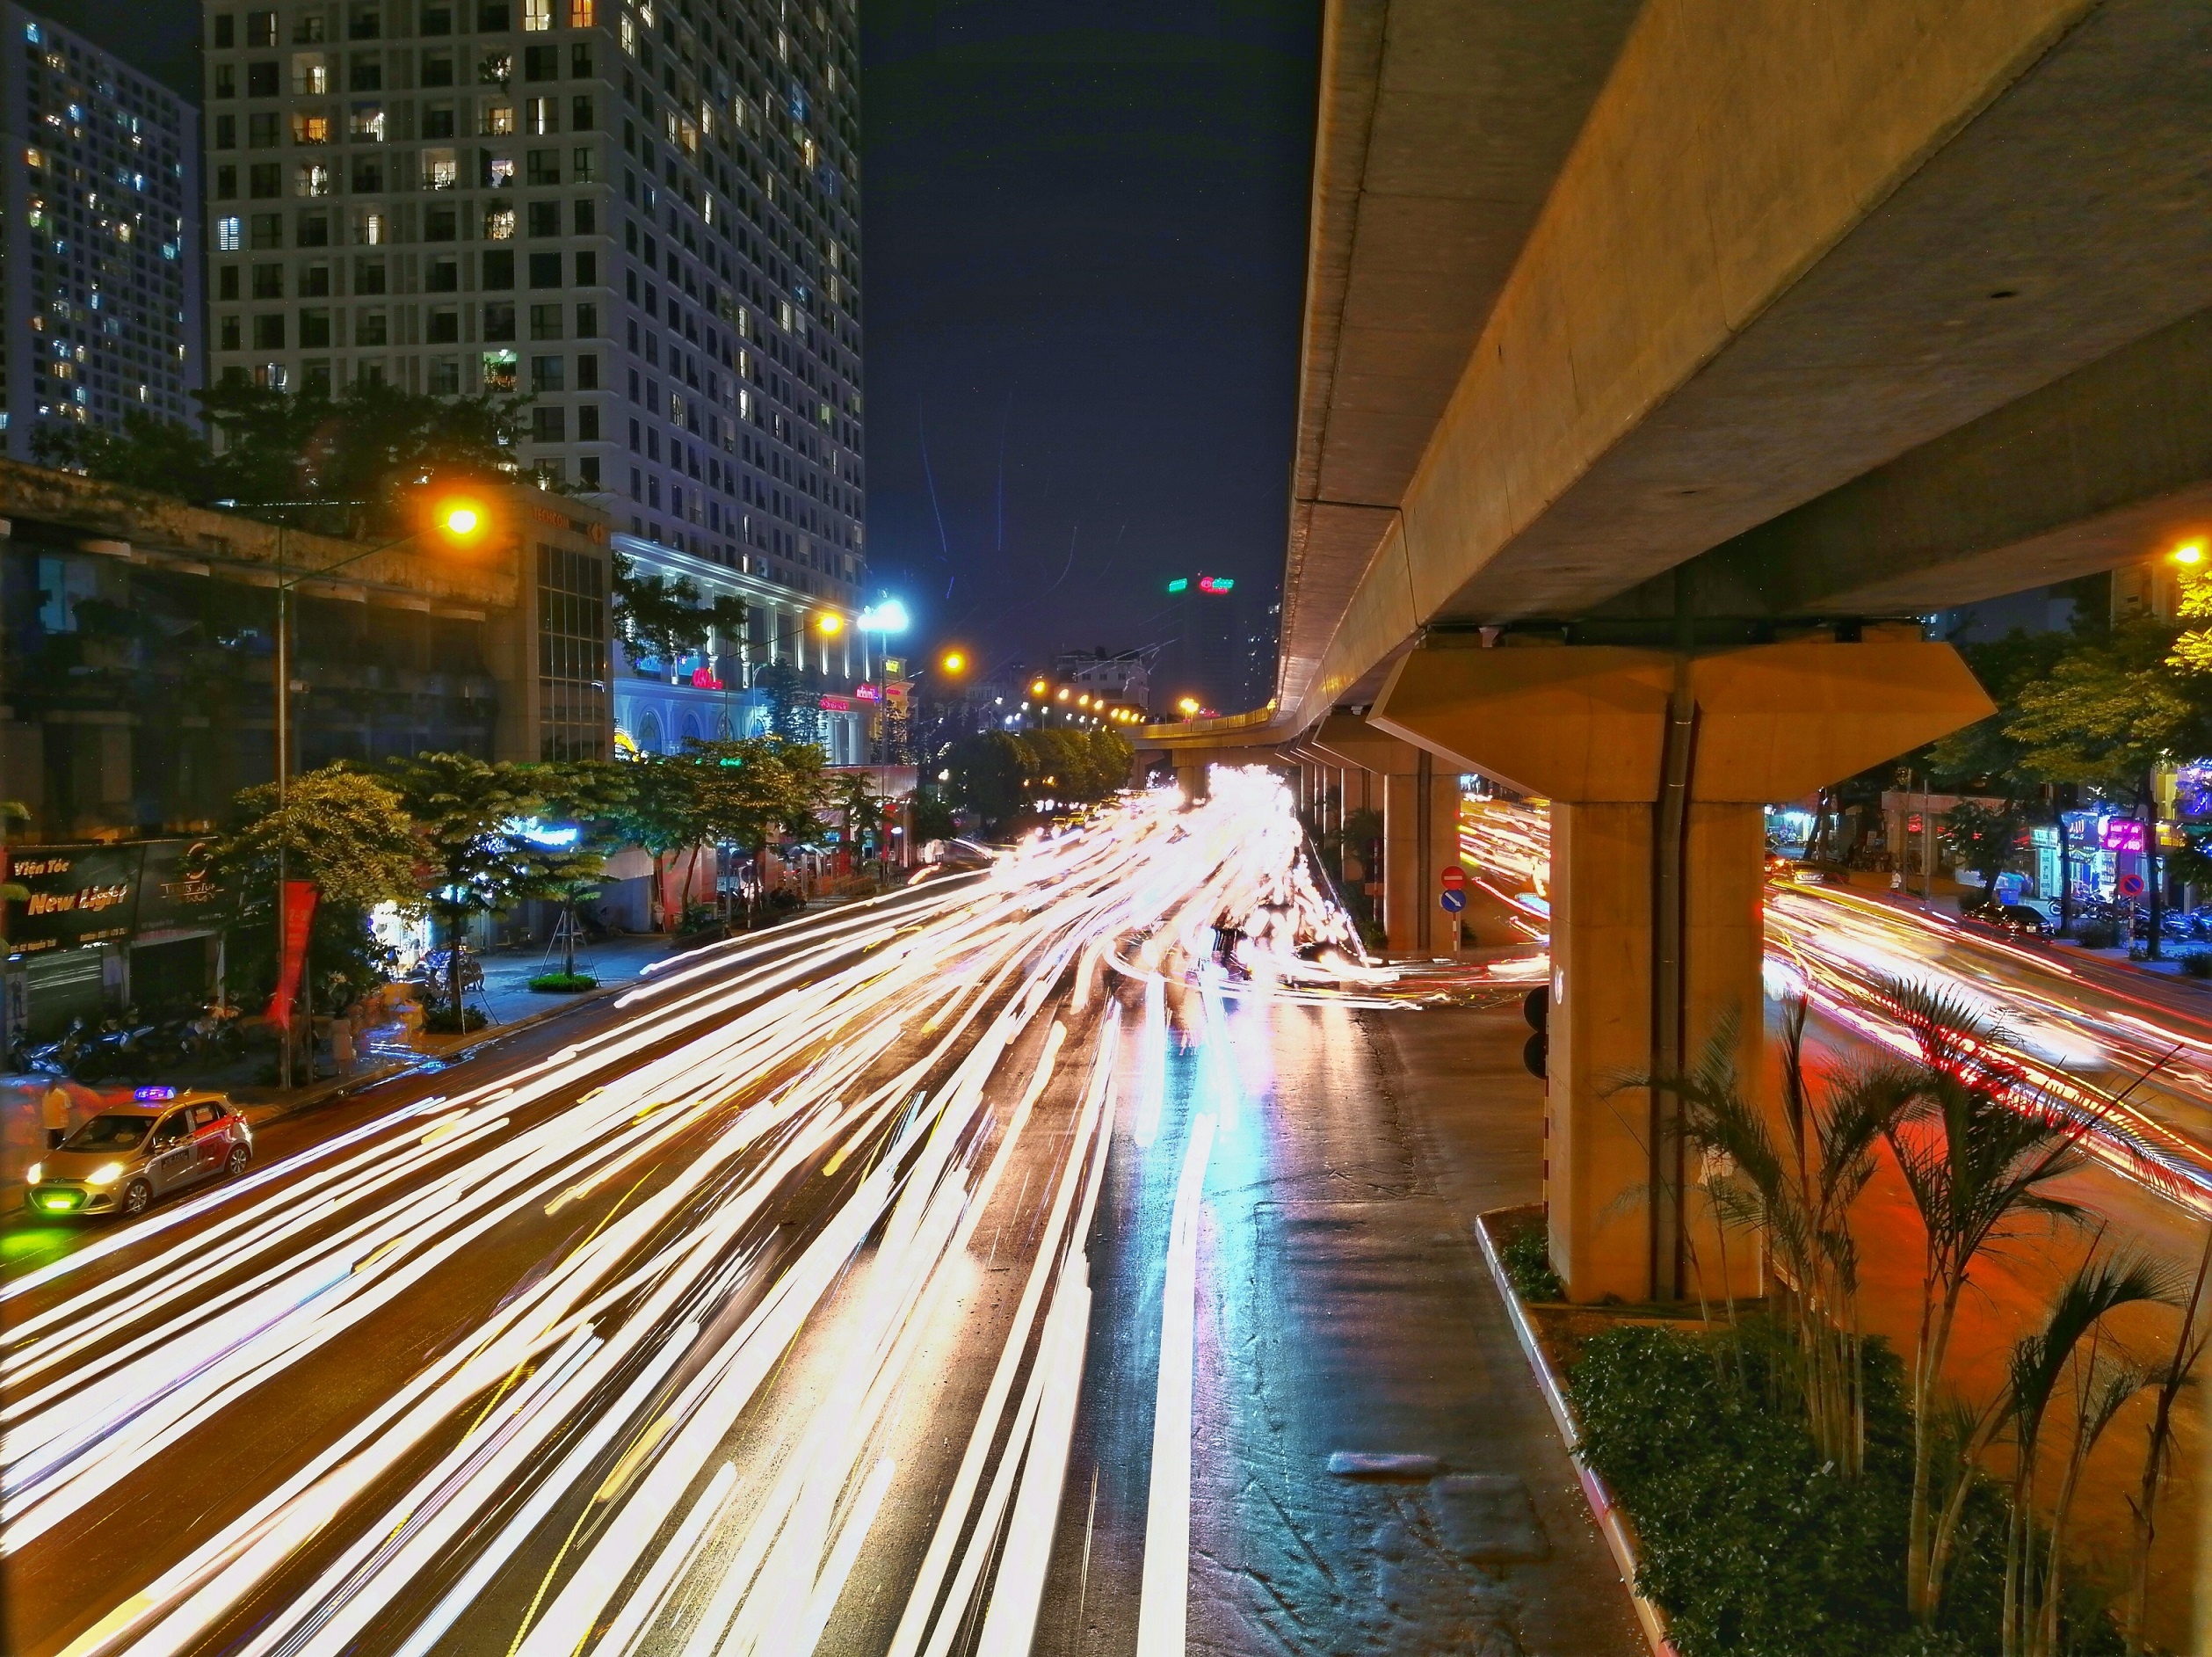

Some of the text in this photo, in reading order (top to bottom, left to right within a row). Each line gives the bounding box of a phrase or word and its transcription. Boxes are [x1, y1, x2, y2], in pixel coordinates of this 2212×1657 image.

[14, 858, 70, 879] Viện Tóc
[27, 884, 127, 915] New Light
